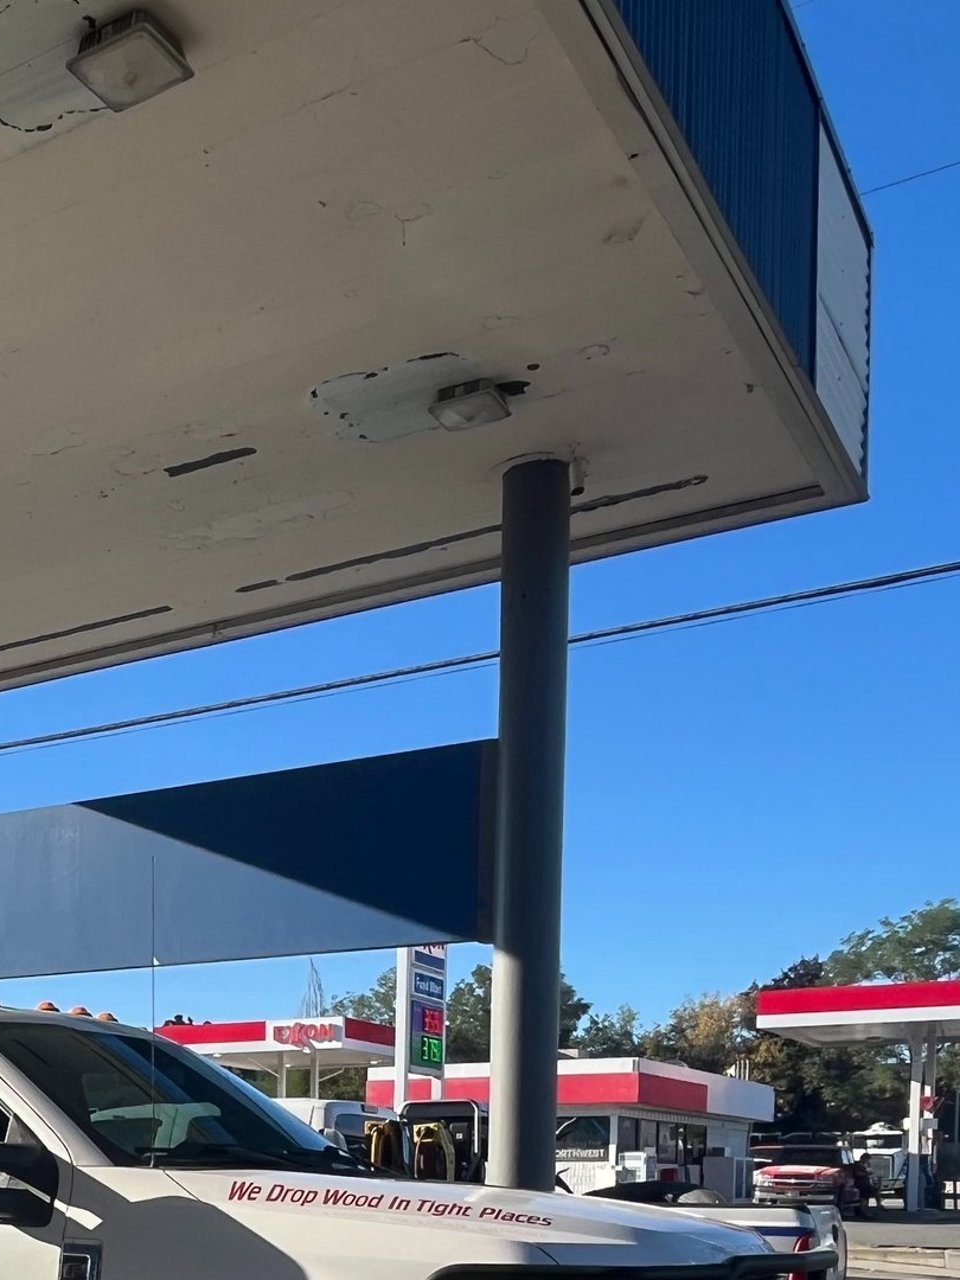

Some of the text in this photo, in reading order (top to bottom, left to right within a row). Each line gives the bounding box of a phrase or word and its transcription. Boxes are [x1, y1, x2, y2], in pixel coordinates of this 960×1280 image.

[556, 1149, 605, 1158] ORTHWEST
[228, 1181, 552, 1227] We Drop Wood In Tight Places
